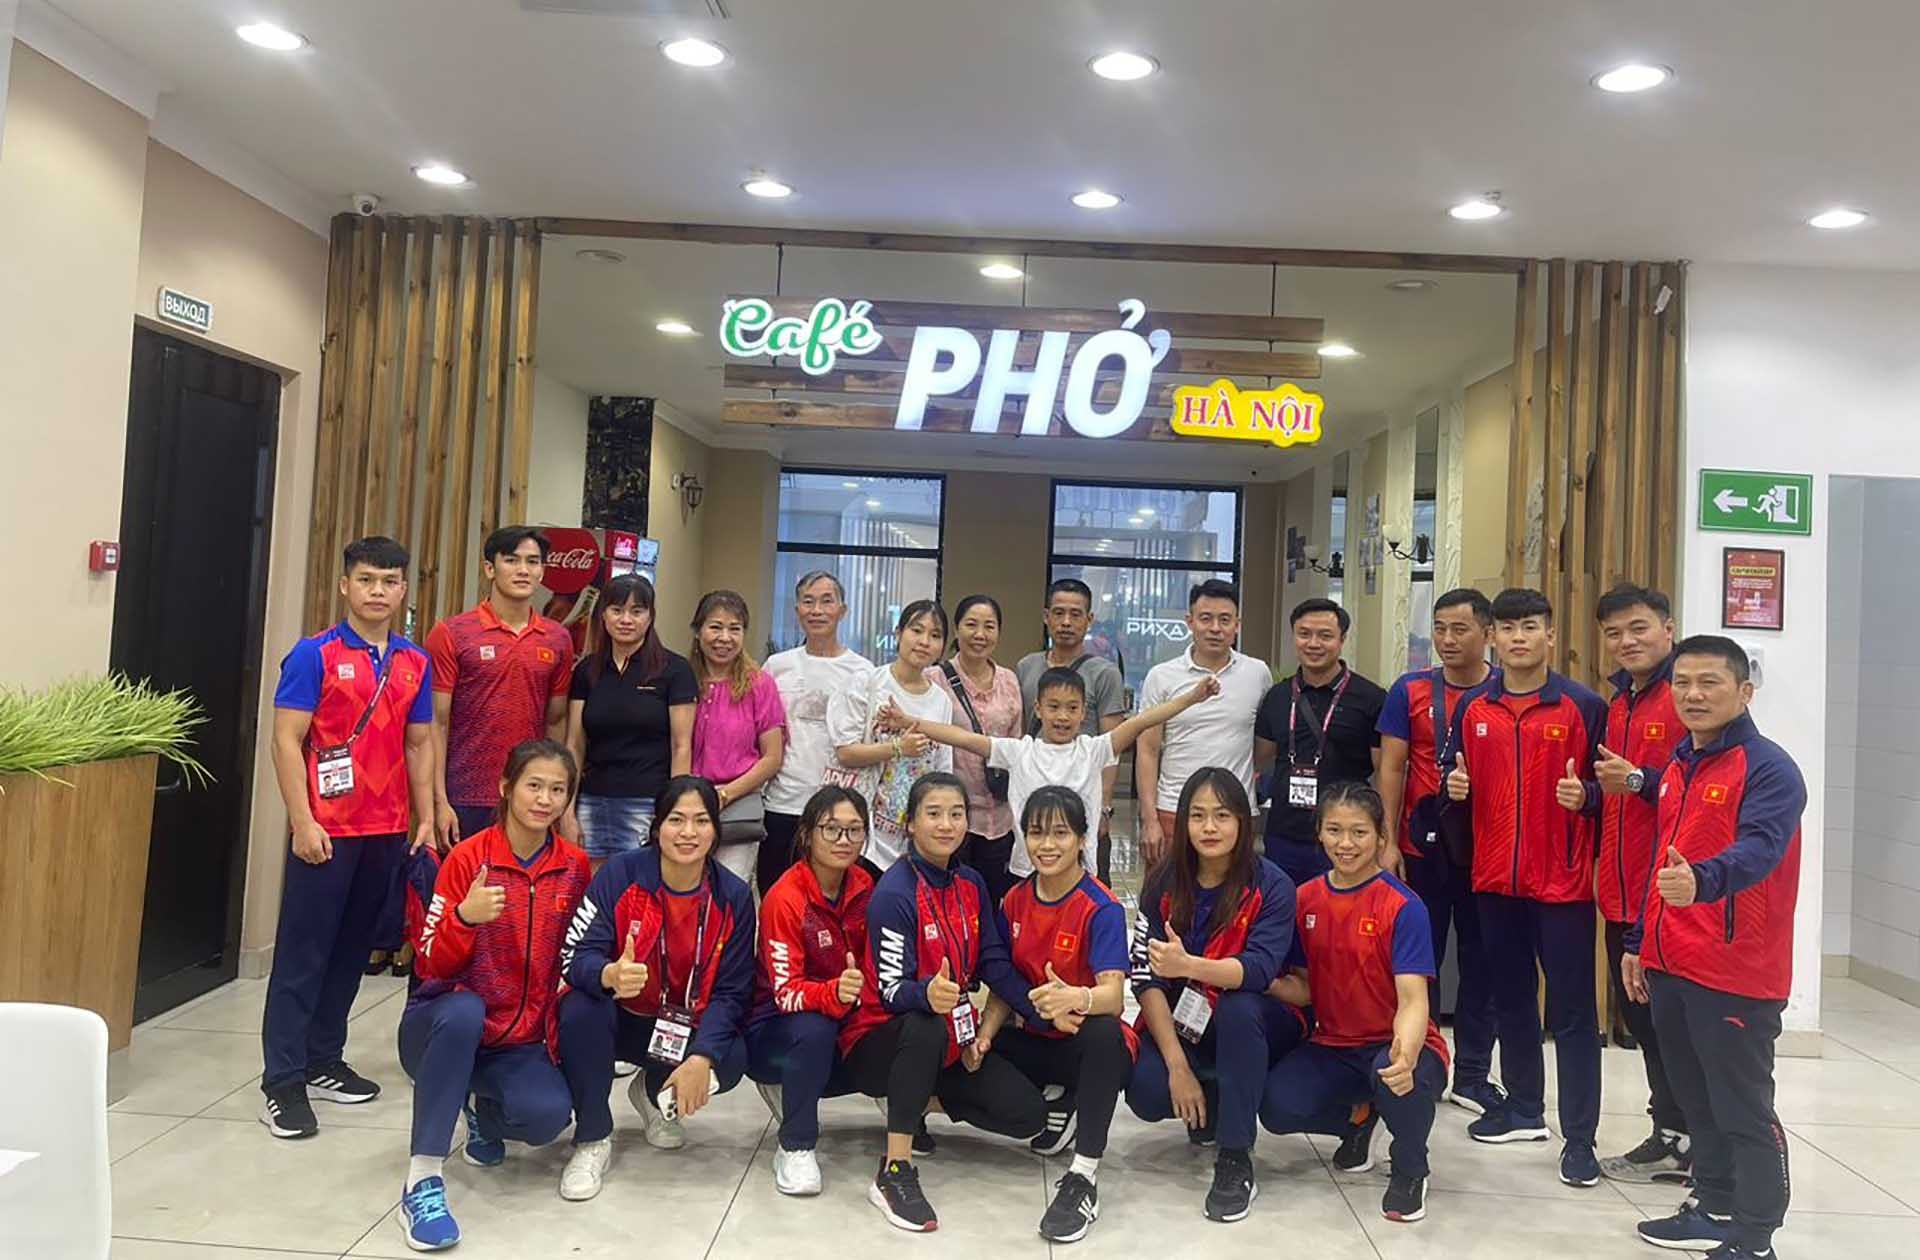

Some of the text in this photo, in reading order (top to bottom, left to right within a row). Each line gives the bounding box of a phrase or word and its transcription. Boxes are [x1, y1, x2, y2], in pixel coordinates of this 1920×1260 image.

[166, 296, 206, 323] ВЫХОД
[721, 299, 882, 374] Café
[894, 299, 1171, 438] PHỞ
[1182, 390, 1315, 437] HÀ NỘI
